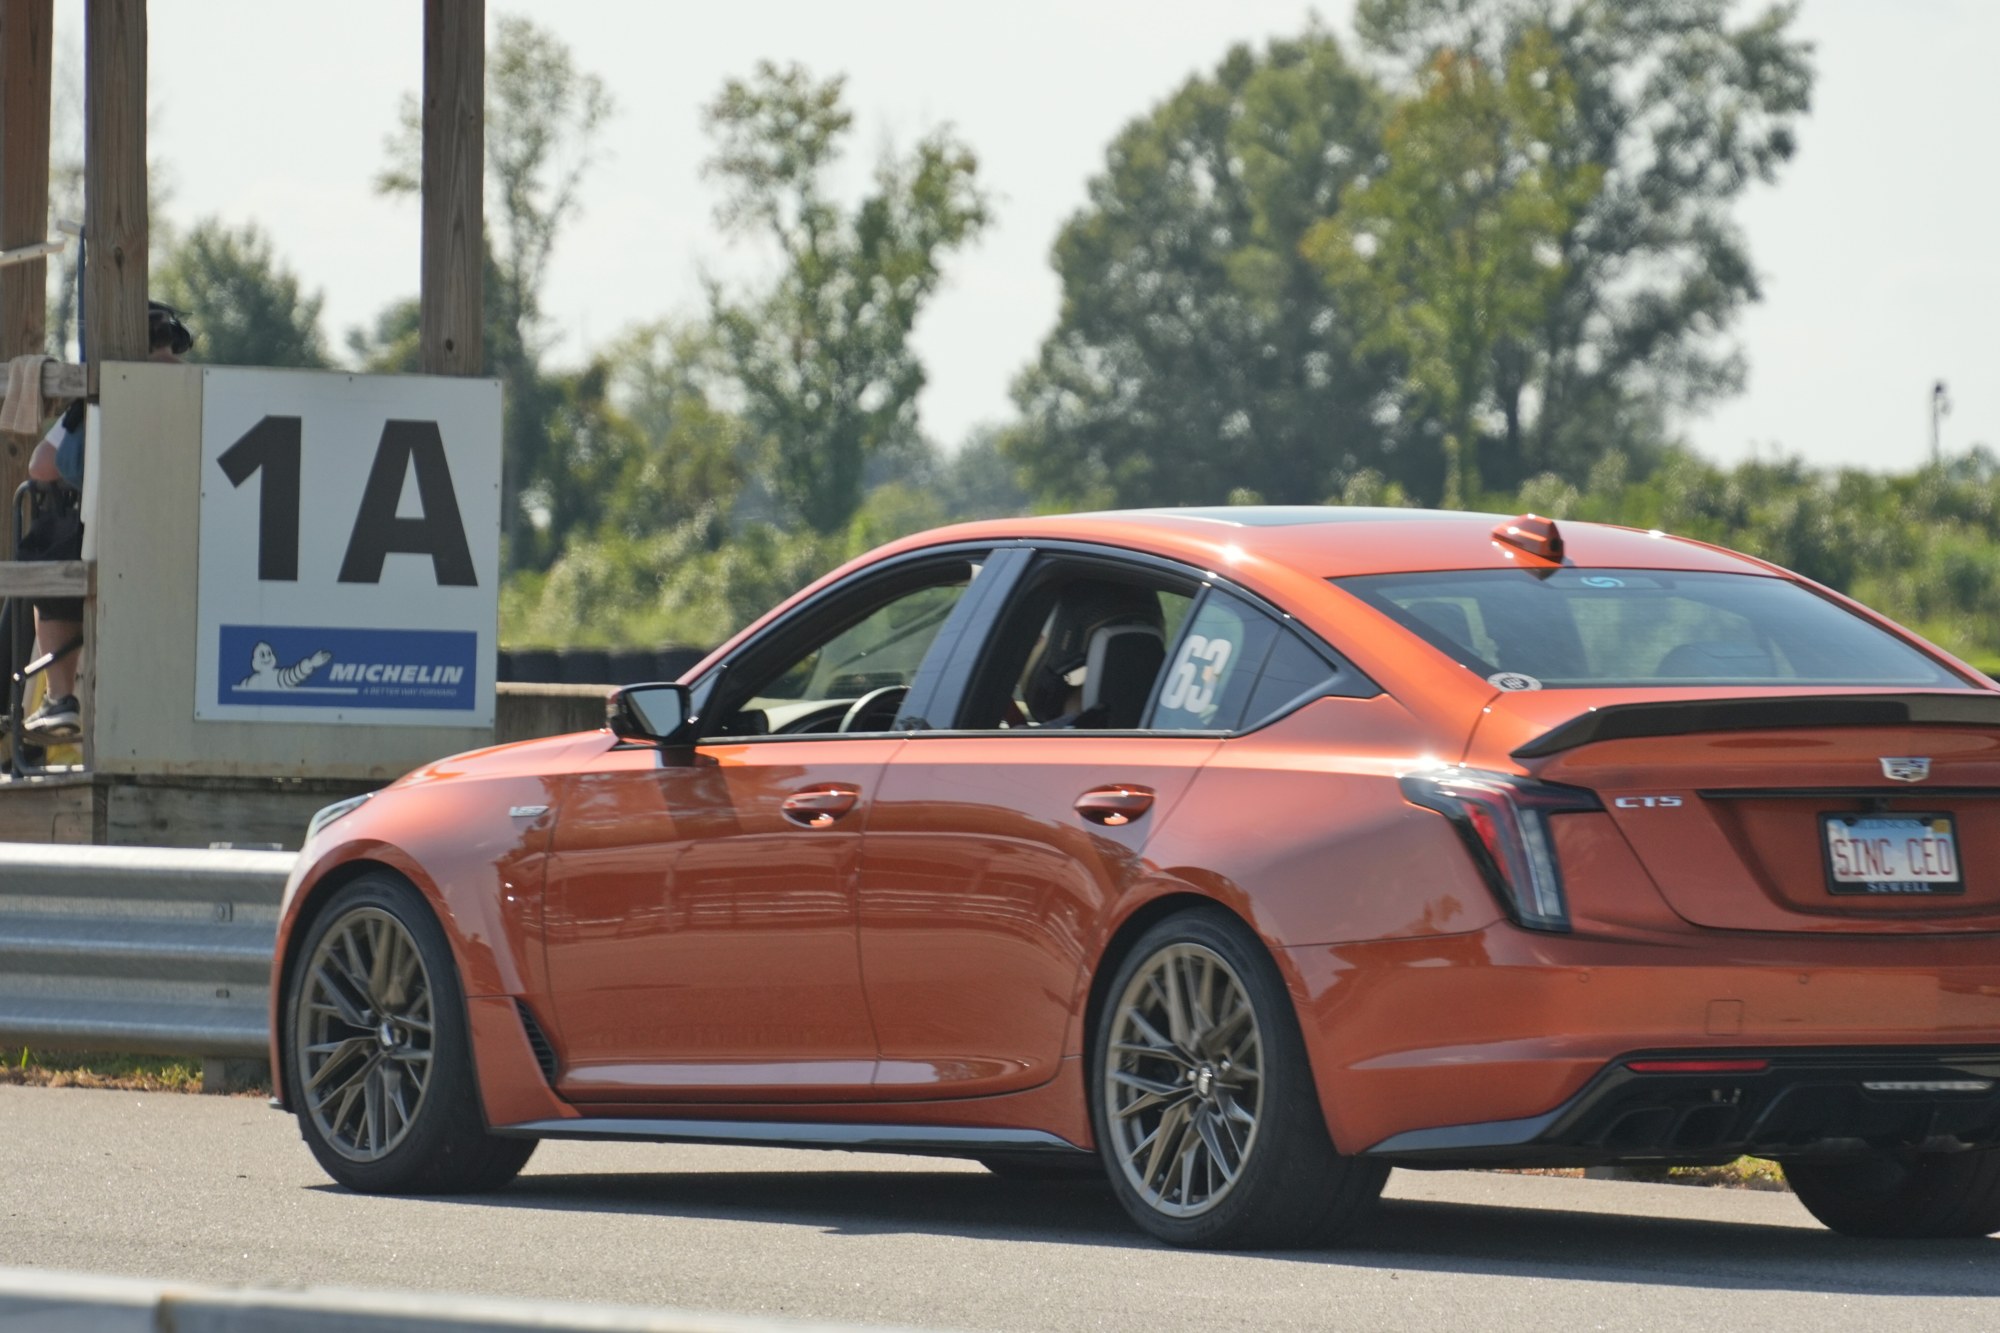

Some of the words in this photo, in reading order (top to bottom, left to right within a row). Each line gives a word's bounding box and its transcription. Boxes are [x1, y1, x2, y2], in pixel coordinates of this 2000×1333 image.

[216, 415, 478, 587] 1A
[329, 663, 464, 684] MICHELIN
[1160, 634, 1232, 713] 63
[1834, 838, 1894, 876] SINC
[1906, 838, 1953, 876] CEO
[1867, 881, 1932, 892] SEWELL
